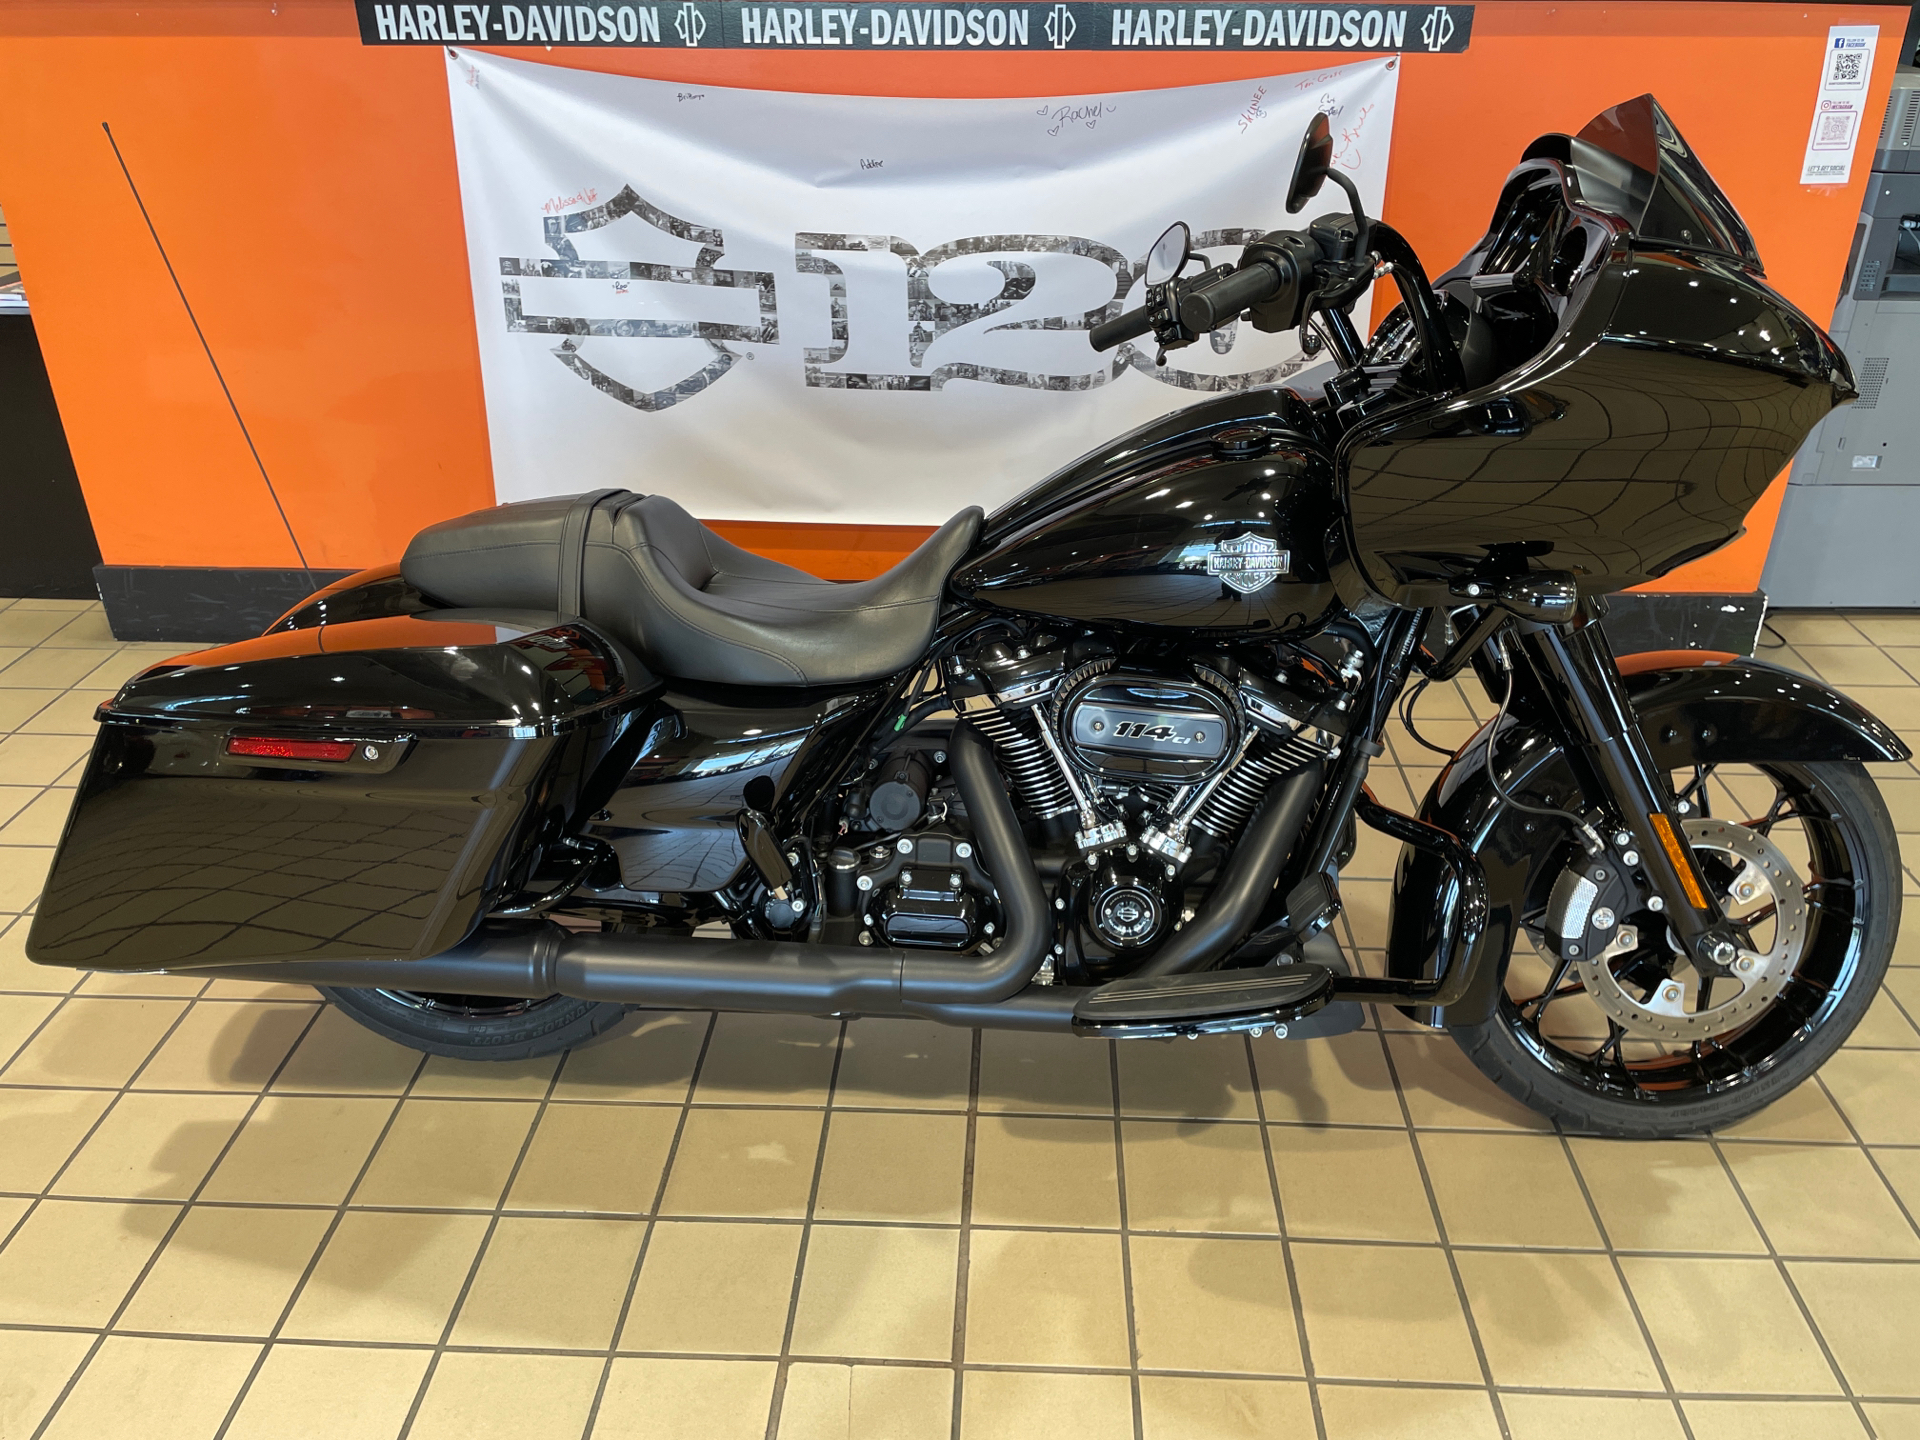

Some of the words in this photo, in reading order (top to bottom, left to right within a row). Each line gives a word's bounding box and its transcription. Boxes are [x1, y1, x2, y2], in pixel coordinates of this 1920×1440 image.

[375, 4, 661, 43] HARLEY-DAVIDSON
[742, 8, 1030, 47] HARLEY-DAVIDSON
[1111, 9, 1407, 48] HARLEY-DAVIDSON
[1051, 102, 1102, 128] Rachel
[1113, 720, 1178, 742] 114
